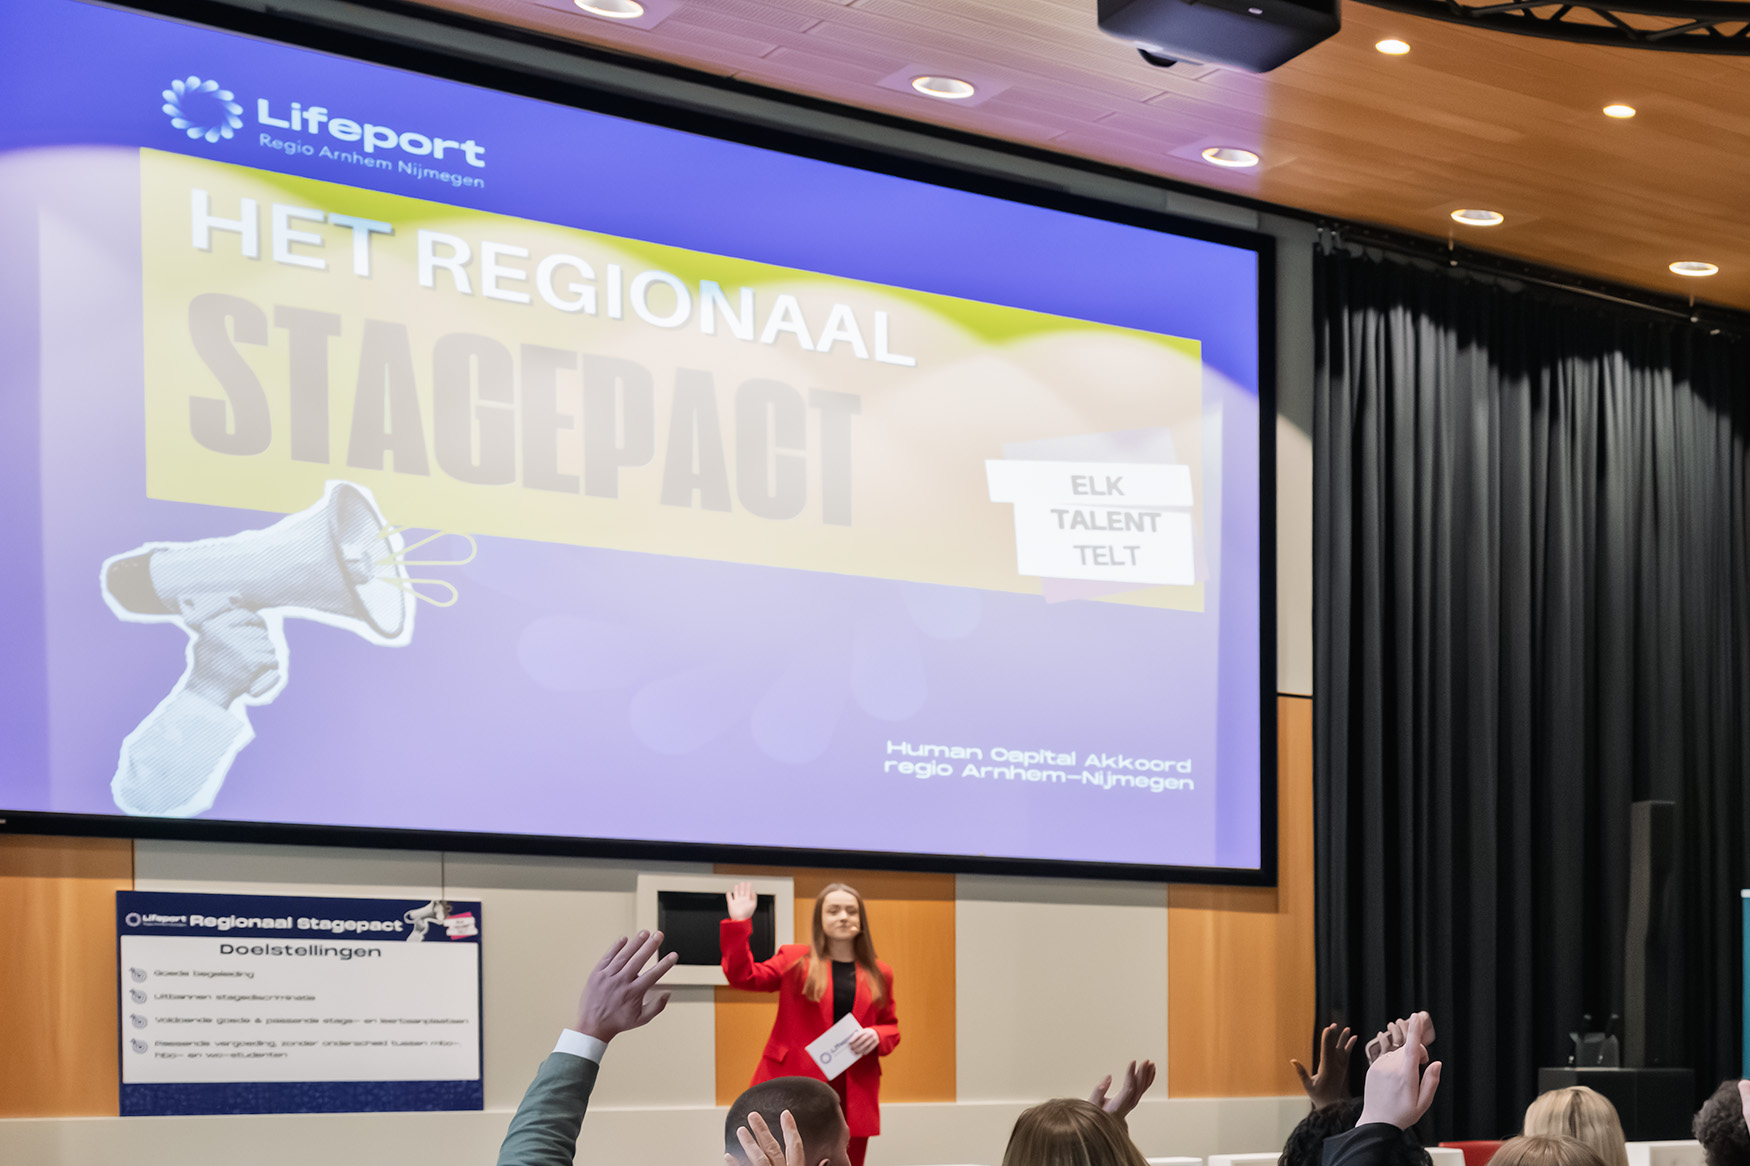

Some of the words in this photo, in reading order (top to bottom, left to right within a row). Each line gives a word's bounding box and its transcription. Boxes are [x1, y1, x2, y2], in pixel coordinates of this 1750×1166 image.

[257, 97, 487, 169] Lifeport
[259, 133, 315, 157] Regio
[319, 145, 393, 172] Arnhem
[398, 160, 486, 191] Nijmegen
[190, 187, 395, 279] HET
[416, 228, 919, 372] REGIONAAL
[187, 291, 863, 528] STAGEPACT
[1070, 475, 1126, 497] ELK
[1050, 508, 1162, 533] TALENT
[1073, 544, 1141, 567] TELT
[884, 757, 954, 779] regio
[961, 763, 1195, 792] Arnhem-Nijmegen
[886, 740, 983, 761] Human
[990, 747, 1077, 770] Capital
[1084, 753, 1193, 775] Akkoord
[190, 914, 293, 931] Regionaal
[296, 917, 403, 933] Stagepact
[220, 944, 381, 960] Doelstellingen
